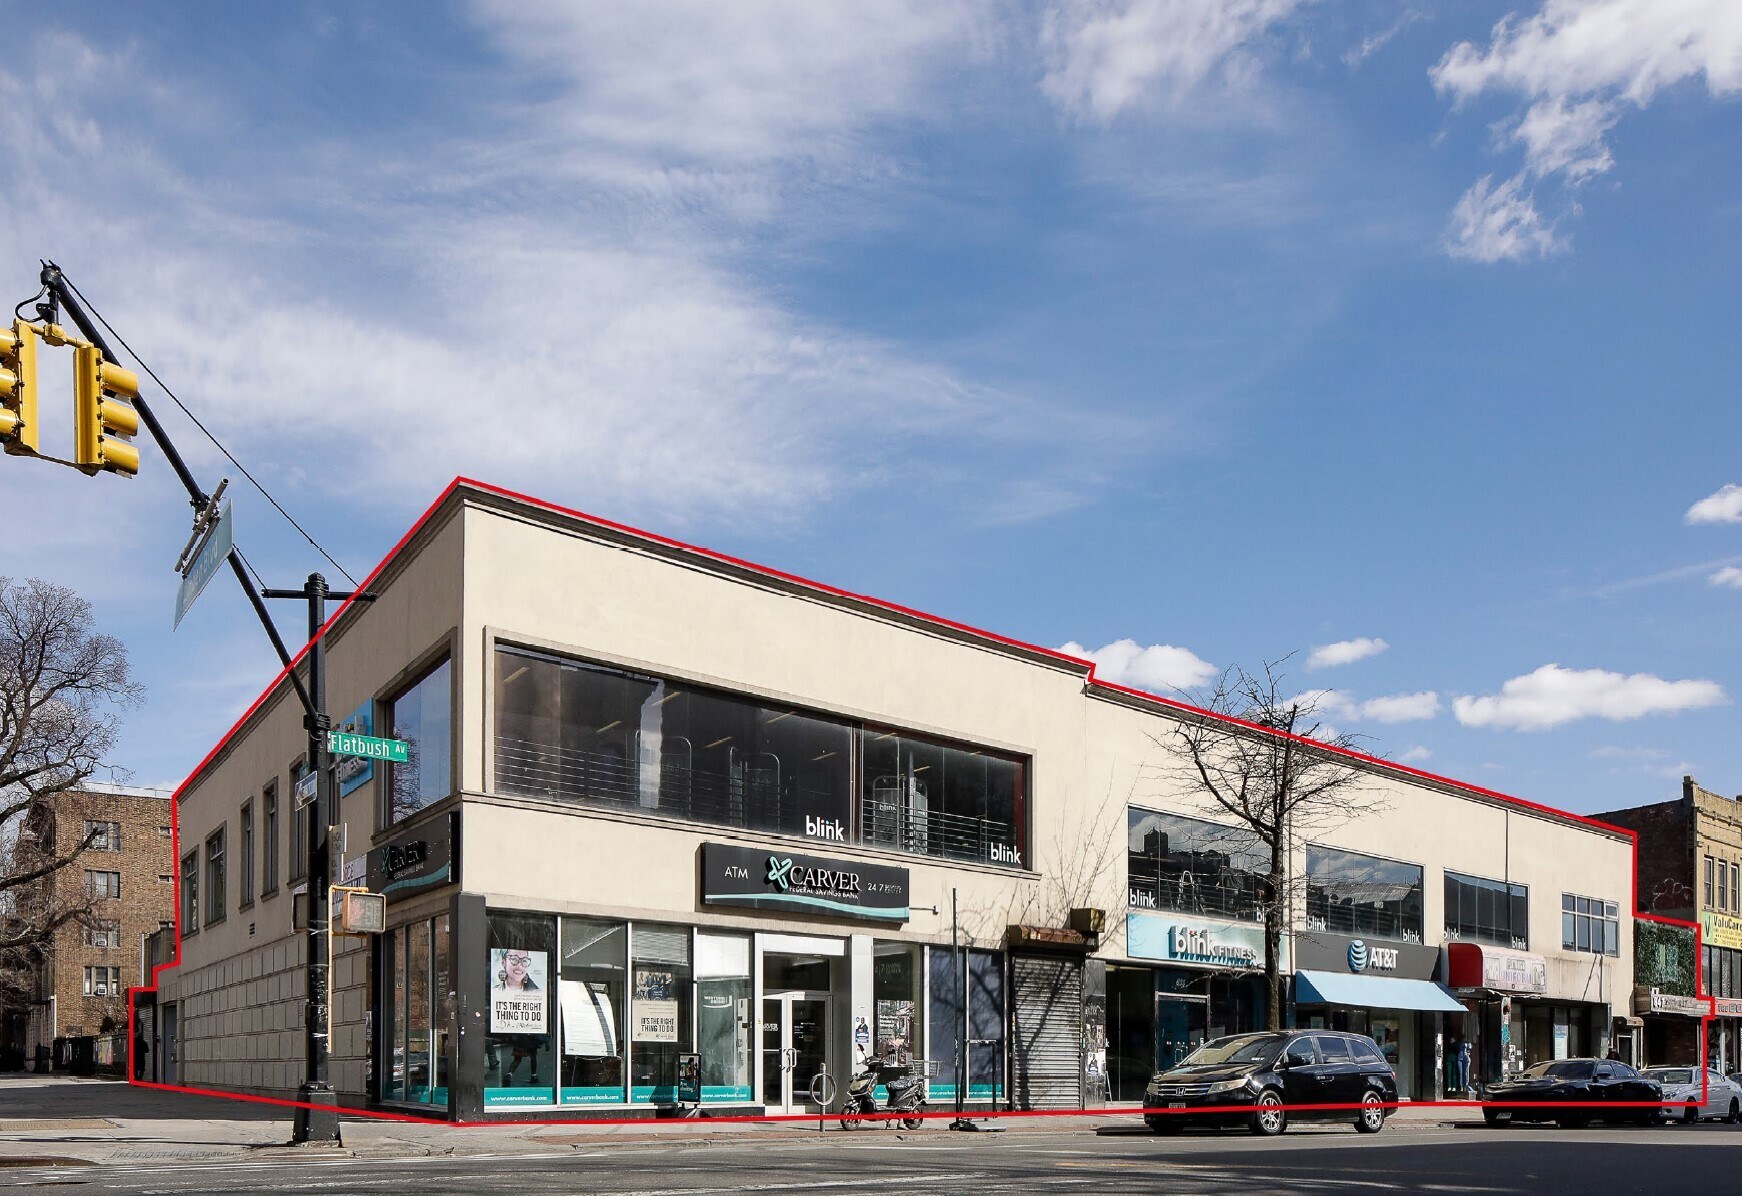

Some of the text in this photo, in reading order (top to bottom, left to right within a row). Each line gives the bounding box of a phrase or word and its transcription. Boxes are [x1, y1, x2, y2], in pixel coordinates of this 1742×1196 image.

[330, 735, 405, 757] Flatbush Av
[806, 815, 845, 841] blink
[990, 842, 1021, 864] blink
[724, 866, 749, 880] ATM
[789, 866, 862, 892] CARVER
[789, 887, 814, 896] FEDERAL
[814, 889, 842, 898] SAVINGS
[1129, 888, 1156, 907] blink
[1306, 915, 1327, 932] blink
[1175, 926, 1257, 960] blink FITNESS
[1402, 928, 1420, 944] blink
[1511, 935, 1526, 950] blink
[1369, 947, 1398, 969] AT&T
[495, 1001, 542, 1011] IT'S THE RIGHT
[496, 1011, 519, 1020] THING
[520, 1011, 530, 1021] TO
[650, 1017, 660, 1025] THE
[660, 1018, 674, 1026] RIGHT
